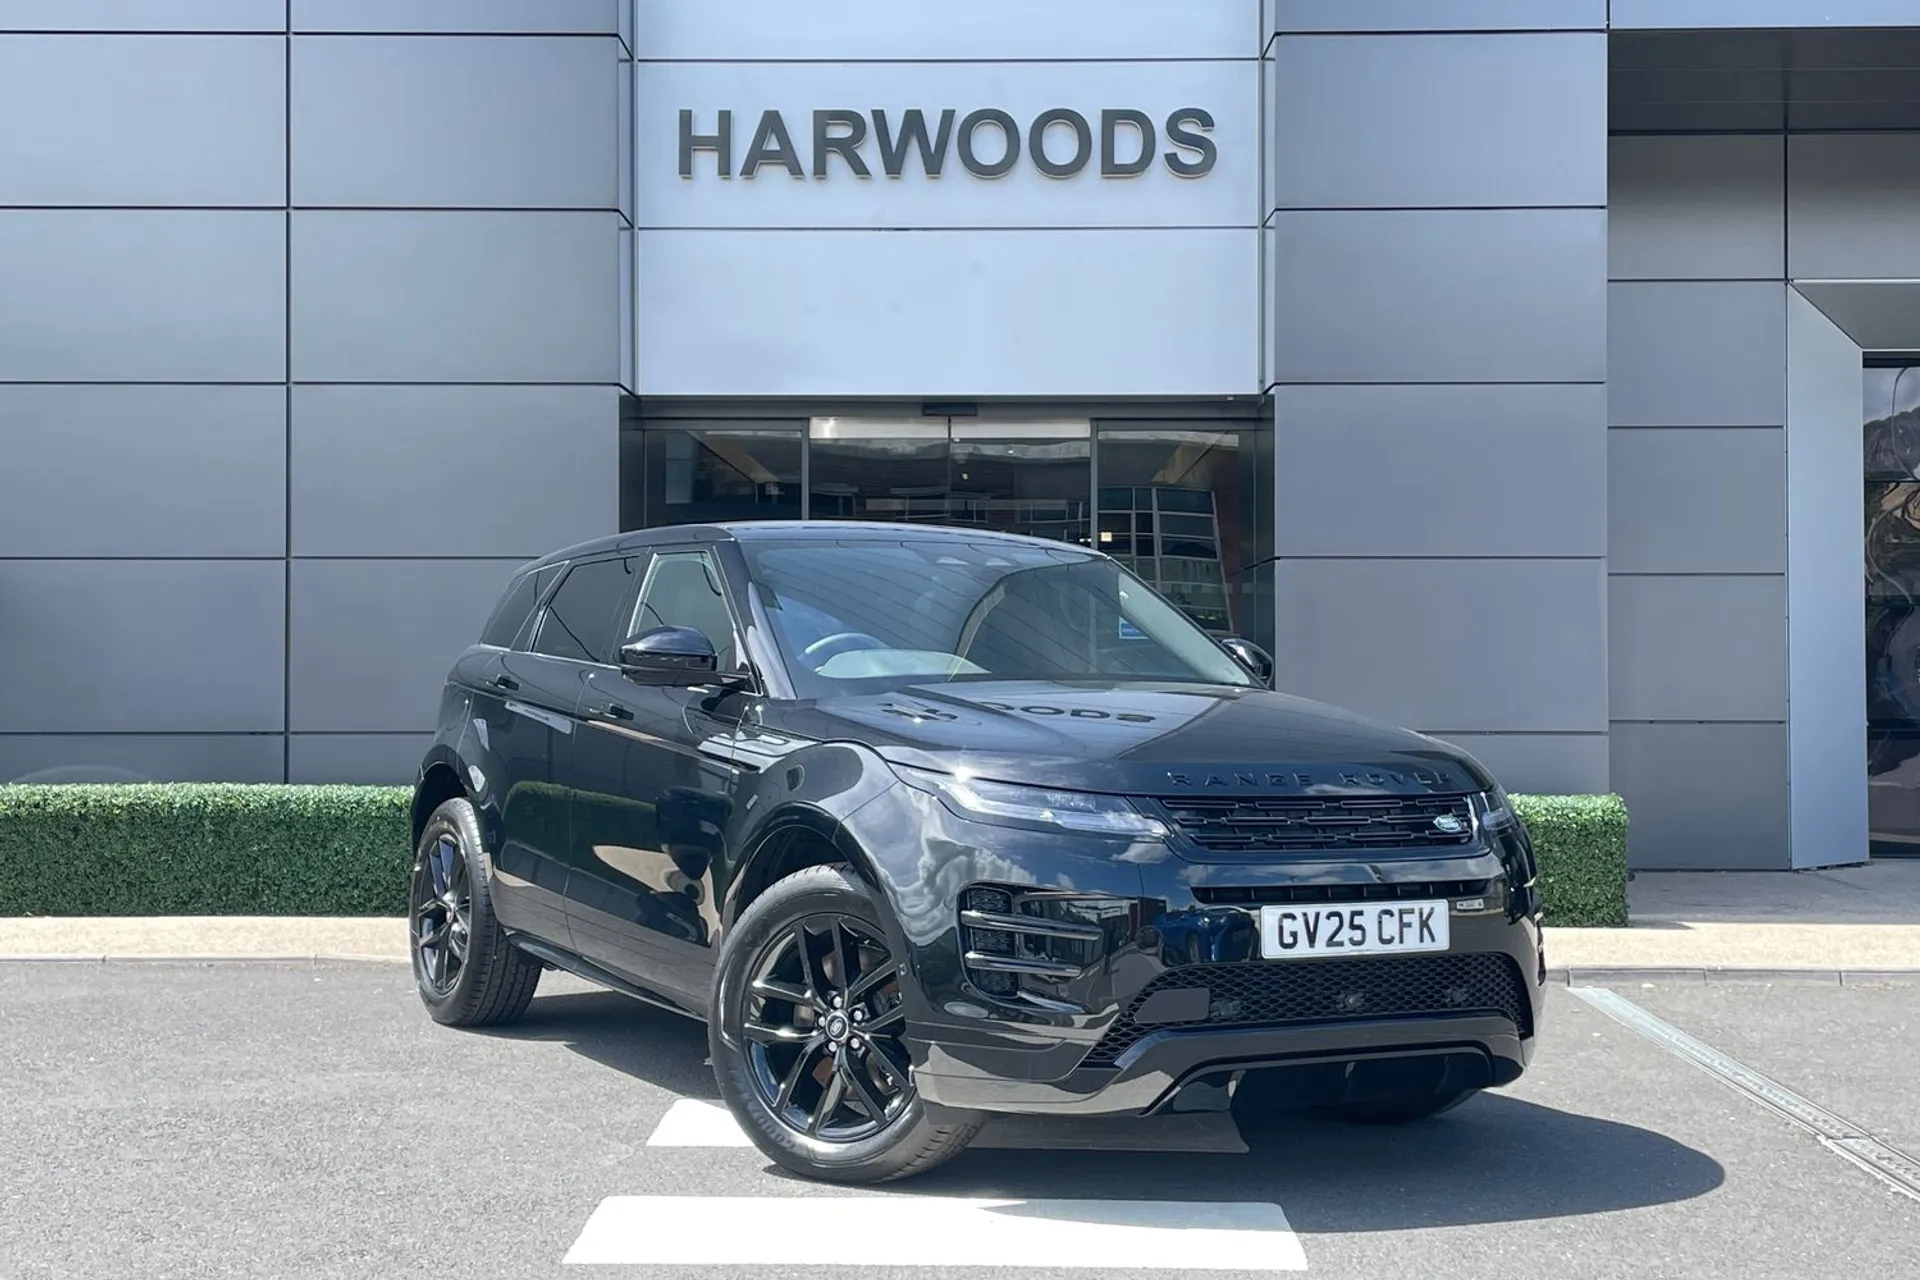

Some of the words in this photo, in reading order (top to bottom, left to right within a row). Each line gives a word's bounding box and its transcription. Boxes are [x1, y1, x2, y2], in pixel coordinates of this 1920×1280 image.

[679, 108, 1217, 179] HARWOODS
[1166, 771, 1314, 786] RANGE
[1277, 911, 1367, 949] GV25
[1377, 907, 1436, 945] CFK
